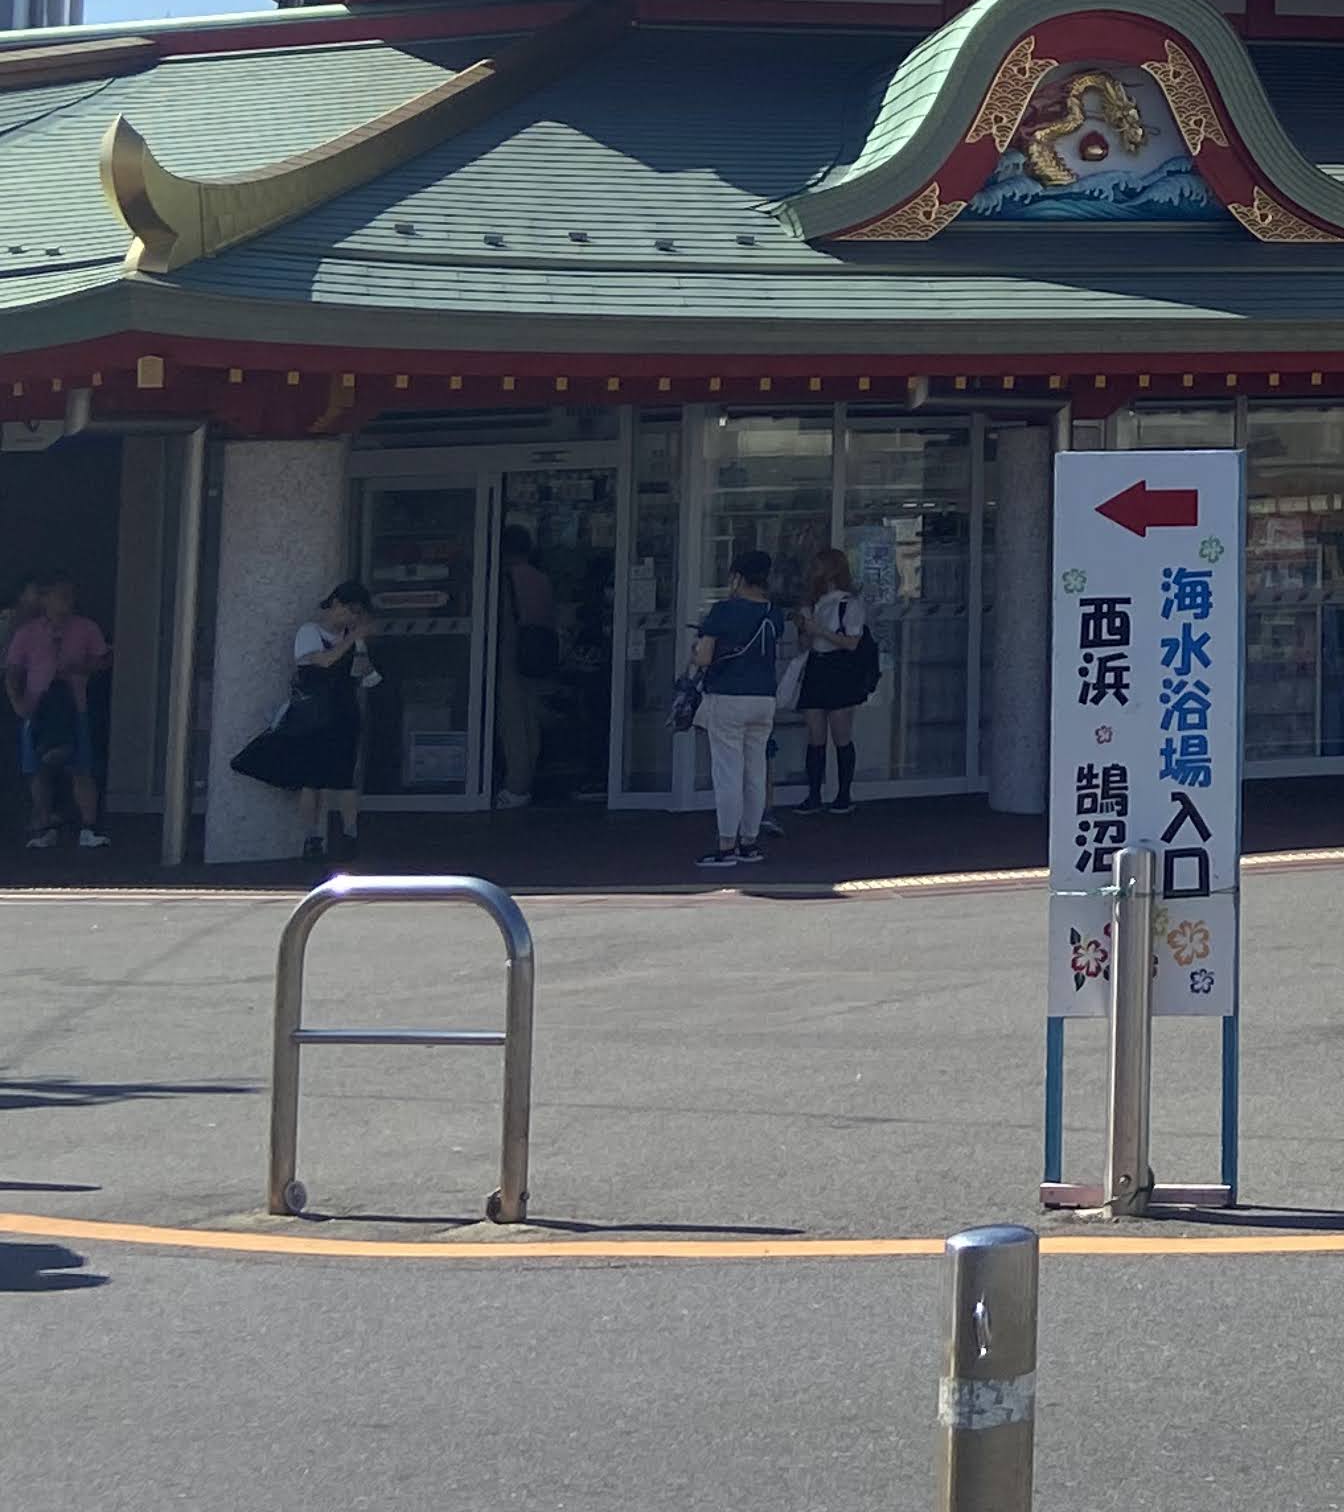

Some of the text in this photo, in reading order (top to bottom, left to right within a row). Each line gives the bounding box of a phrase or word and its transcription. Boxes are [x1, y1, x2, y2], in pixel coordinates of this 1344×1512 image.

[1075, 597, 1132, 873] 西浜 鵠沼
[1159, 567, 1213, 899] 海水浴場入口
